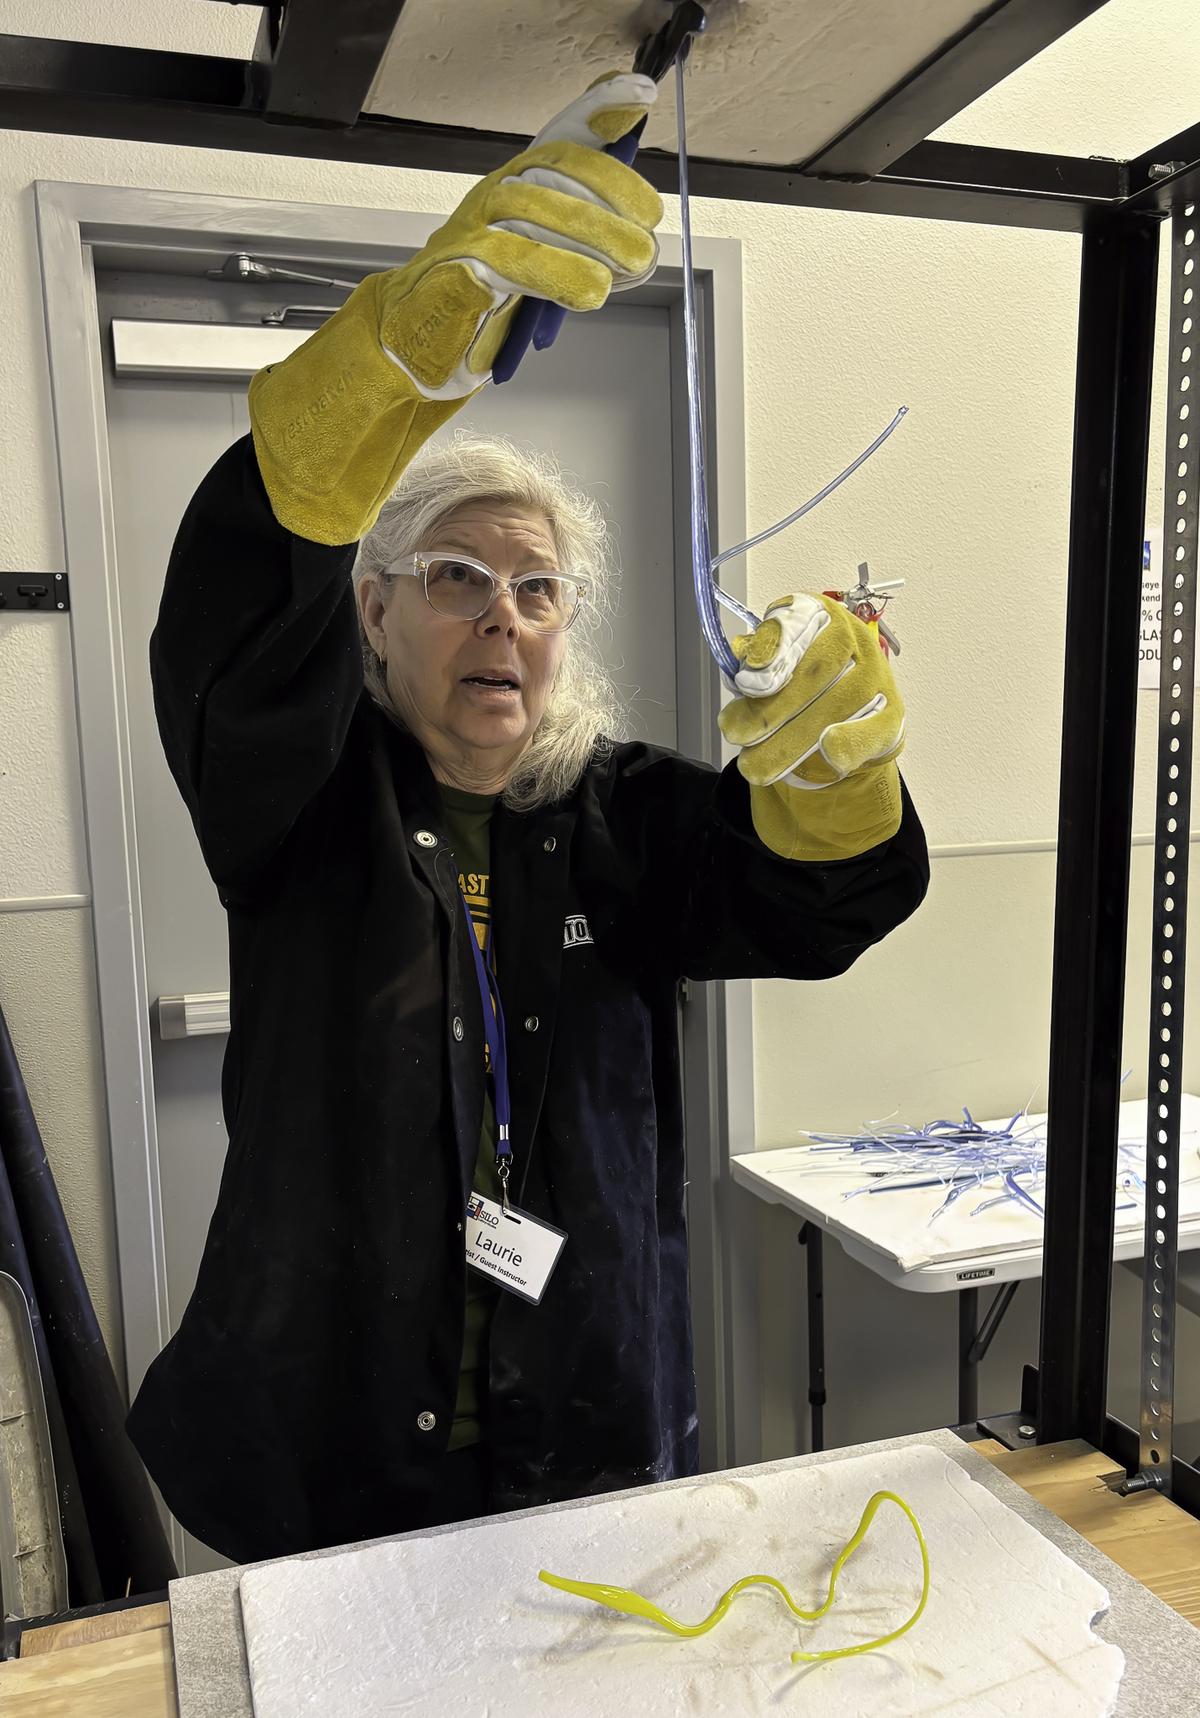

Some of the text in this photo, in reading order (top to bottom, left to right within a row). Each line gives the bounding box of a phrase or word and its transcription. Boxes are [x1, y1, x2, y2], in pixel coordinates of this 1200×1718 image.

[1140, 629, 1161, 641] LA
[479, 1210, 500, 1226] SILO
[475, 1231, 523, 1267] Laurie
[479, 1256, 498, 1271] Guest
[497, 1266, 527, 1286] Instructor
